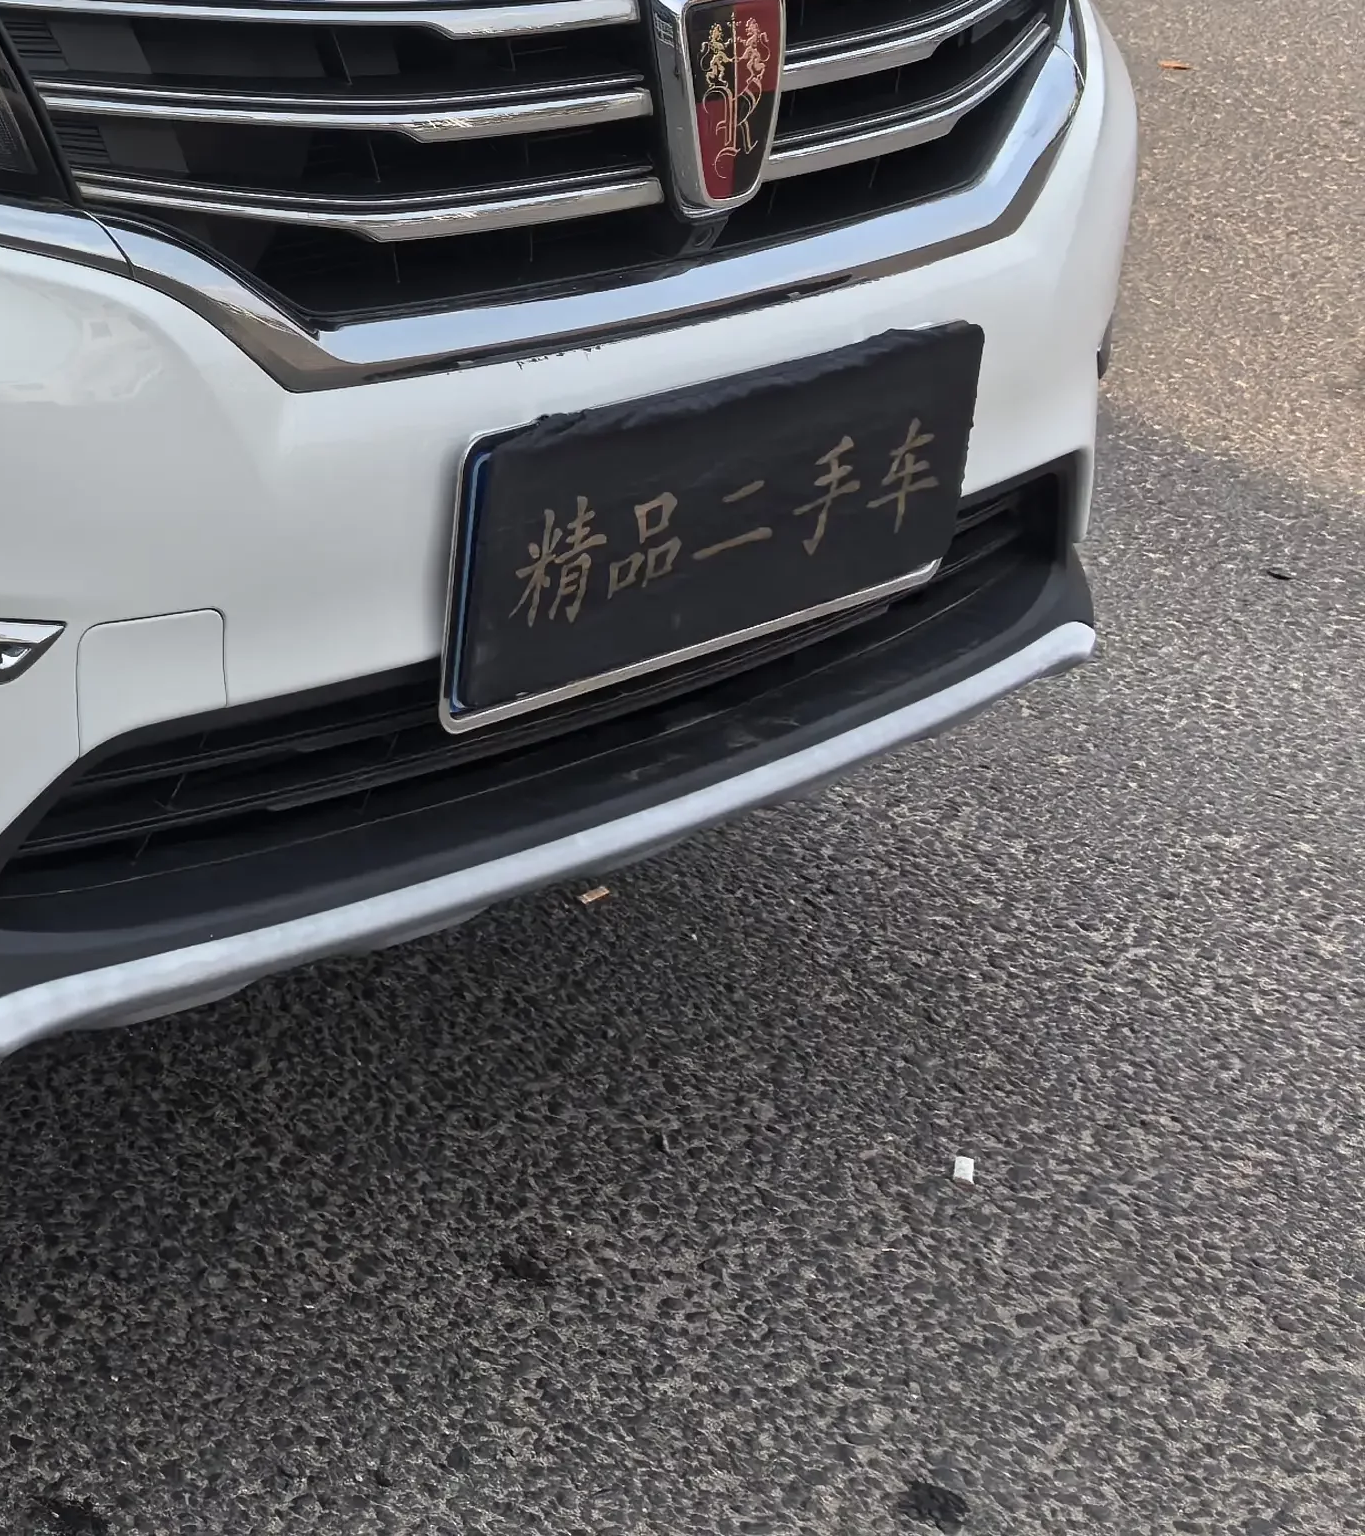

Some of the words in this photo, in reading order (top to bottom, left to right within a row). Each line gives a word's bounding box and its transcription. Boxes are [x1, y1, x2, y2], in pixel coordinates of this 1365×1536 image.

[508, 417, 940, 628] 精品二手车
